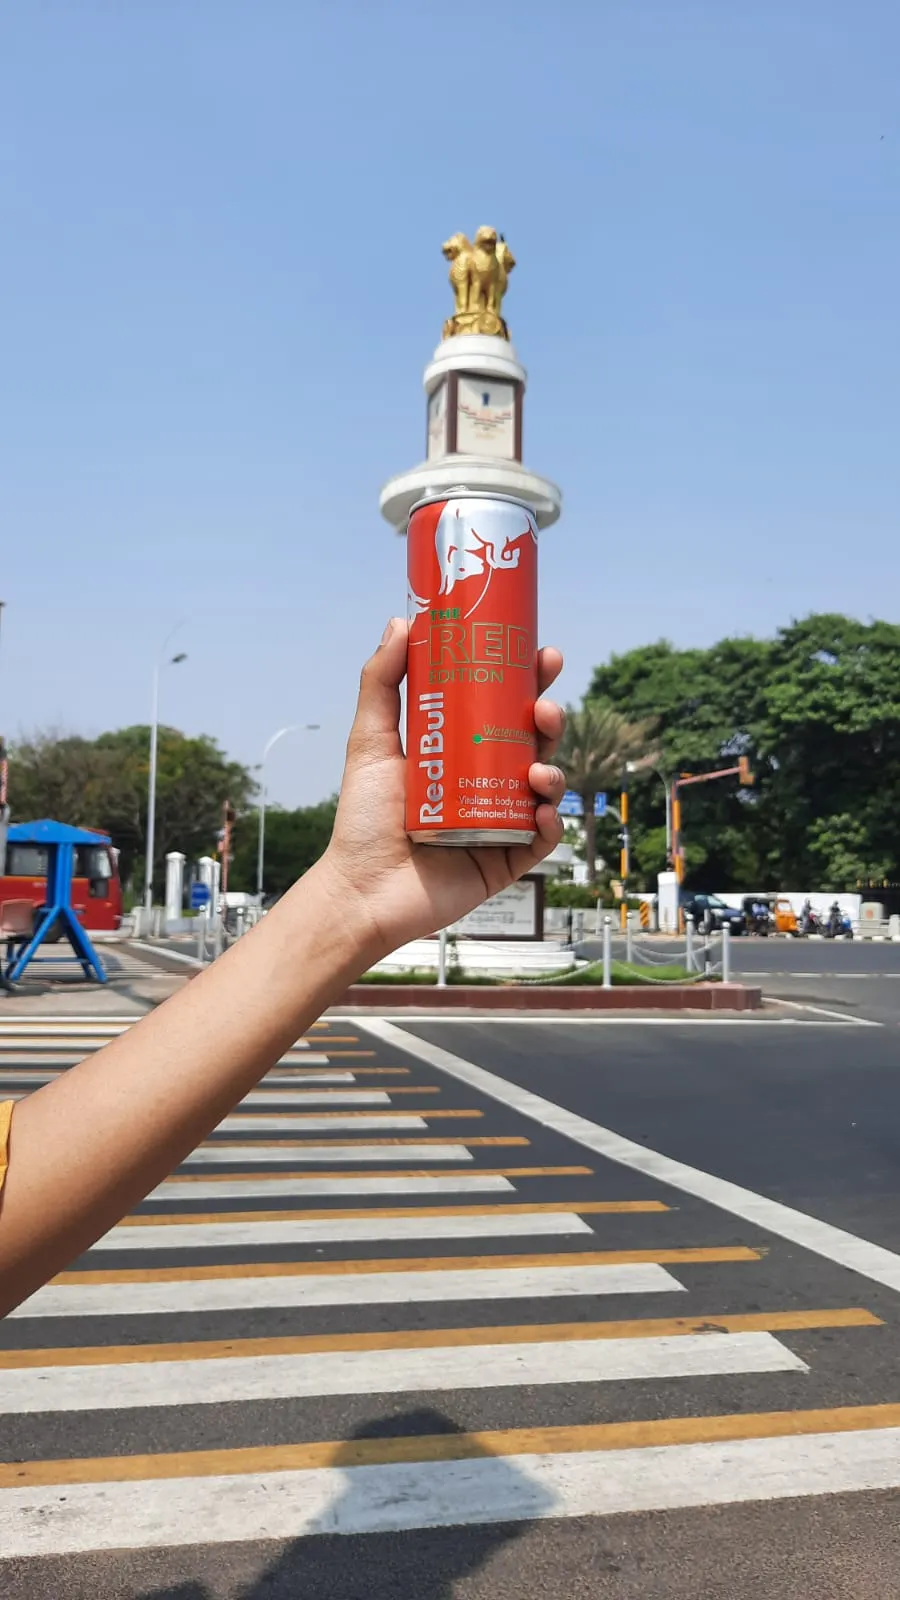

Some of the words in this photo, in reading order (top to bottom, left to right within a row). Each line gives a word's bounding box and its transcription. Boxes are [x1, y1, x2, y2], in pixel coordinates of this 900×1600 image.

[430, 608, 461, 621] THE
[430, 622, 533, 668] RED
[429, 668, 504, 683] EDITION
[419, 691, 445, 754] Bull
[458, 777, 506, 788] ENERGY
[419, 759, 444, 824] Red
[458, 794, 493, 805] Vitalizes
[495, 795, 514, 808] body
[515, 798, 527, 808] and
[458, 807, 507, 819] Caffeinated
